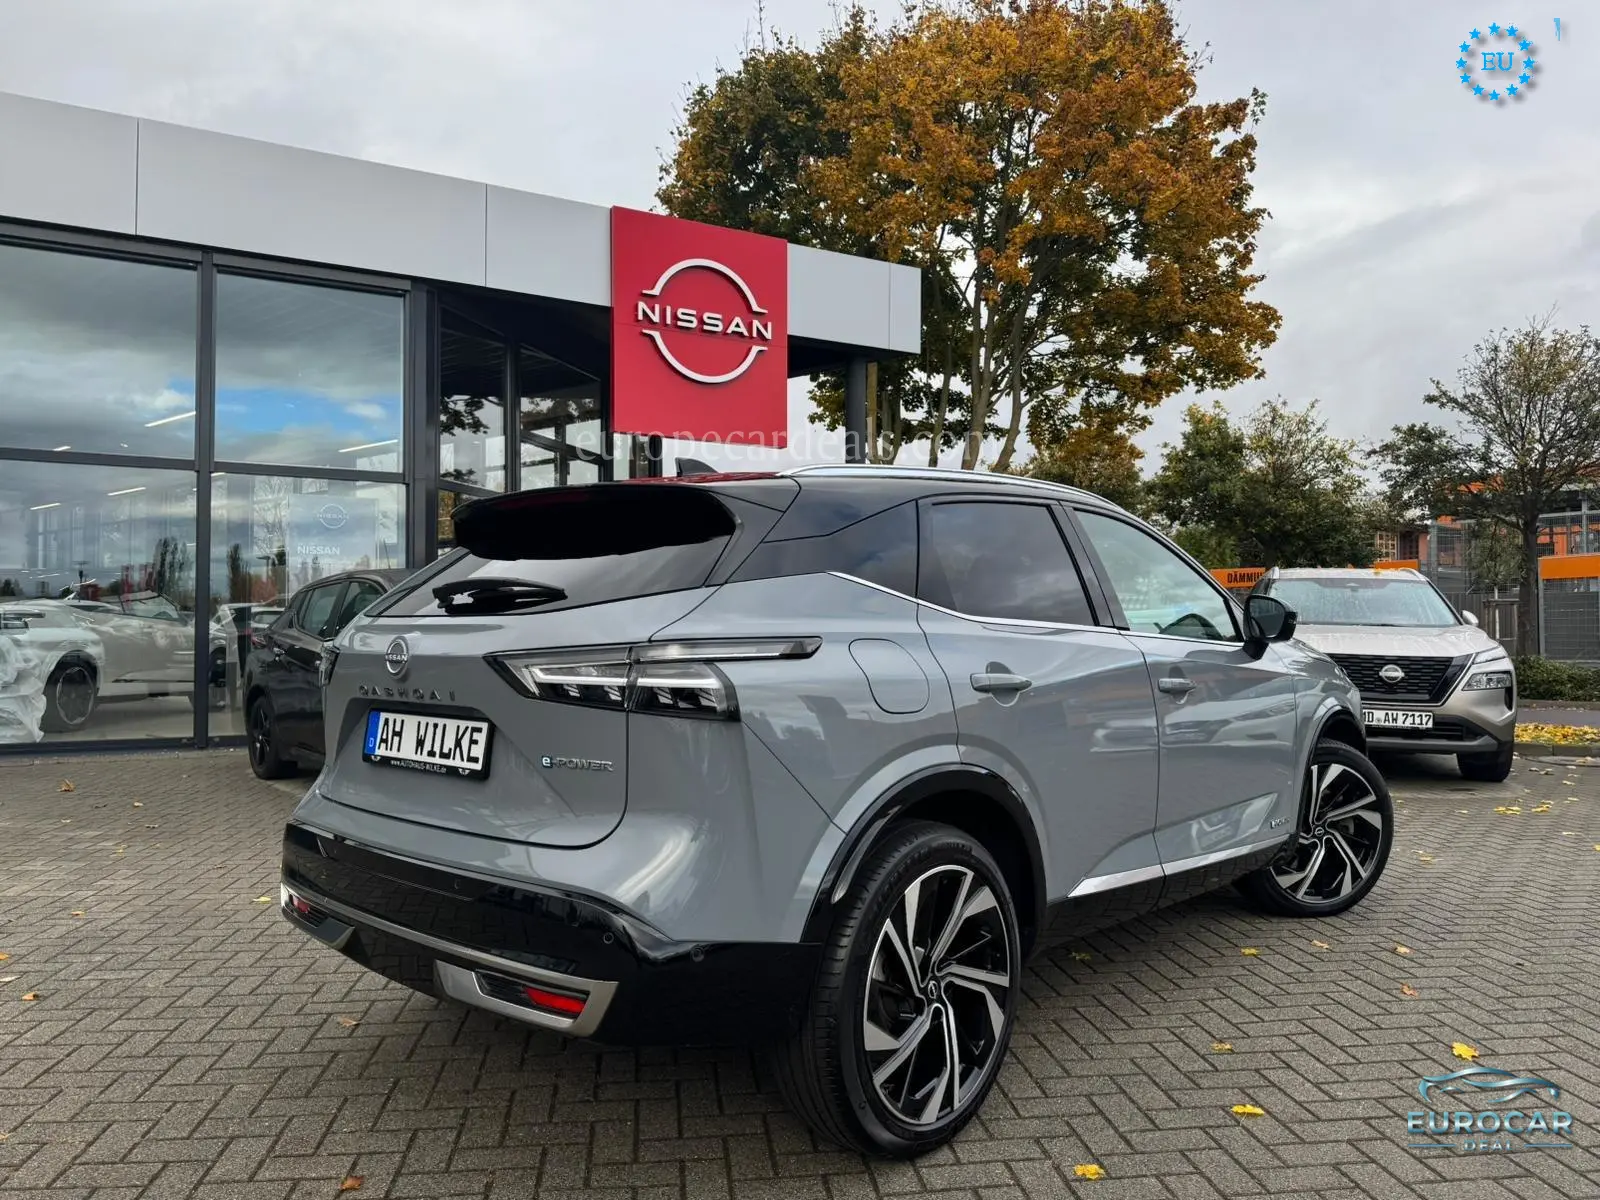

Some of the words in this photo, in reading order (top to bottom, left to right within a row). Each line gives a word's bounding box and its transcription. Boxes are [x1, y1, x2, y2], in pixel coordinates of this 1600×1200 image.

[637, 301, 772, 340] NISSAN
[297, 544, 340, 555] NISSAN
[359, 684, 456, 702] QASHQAI
[1383, 711, 1399, 725] AW
[1401, 712, 1432, 727] 7117
[368, 737, 375, 748] D
[378, 717, 404, 753] AH
[415, 720, 483, 764] WILKE
